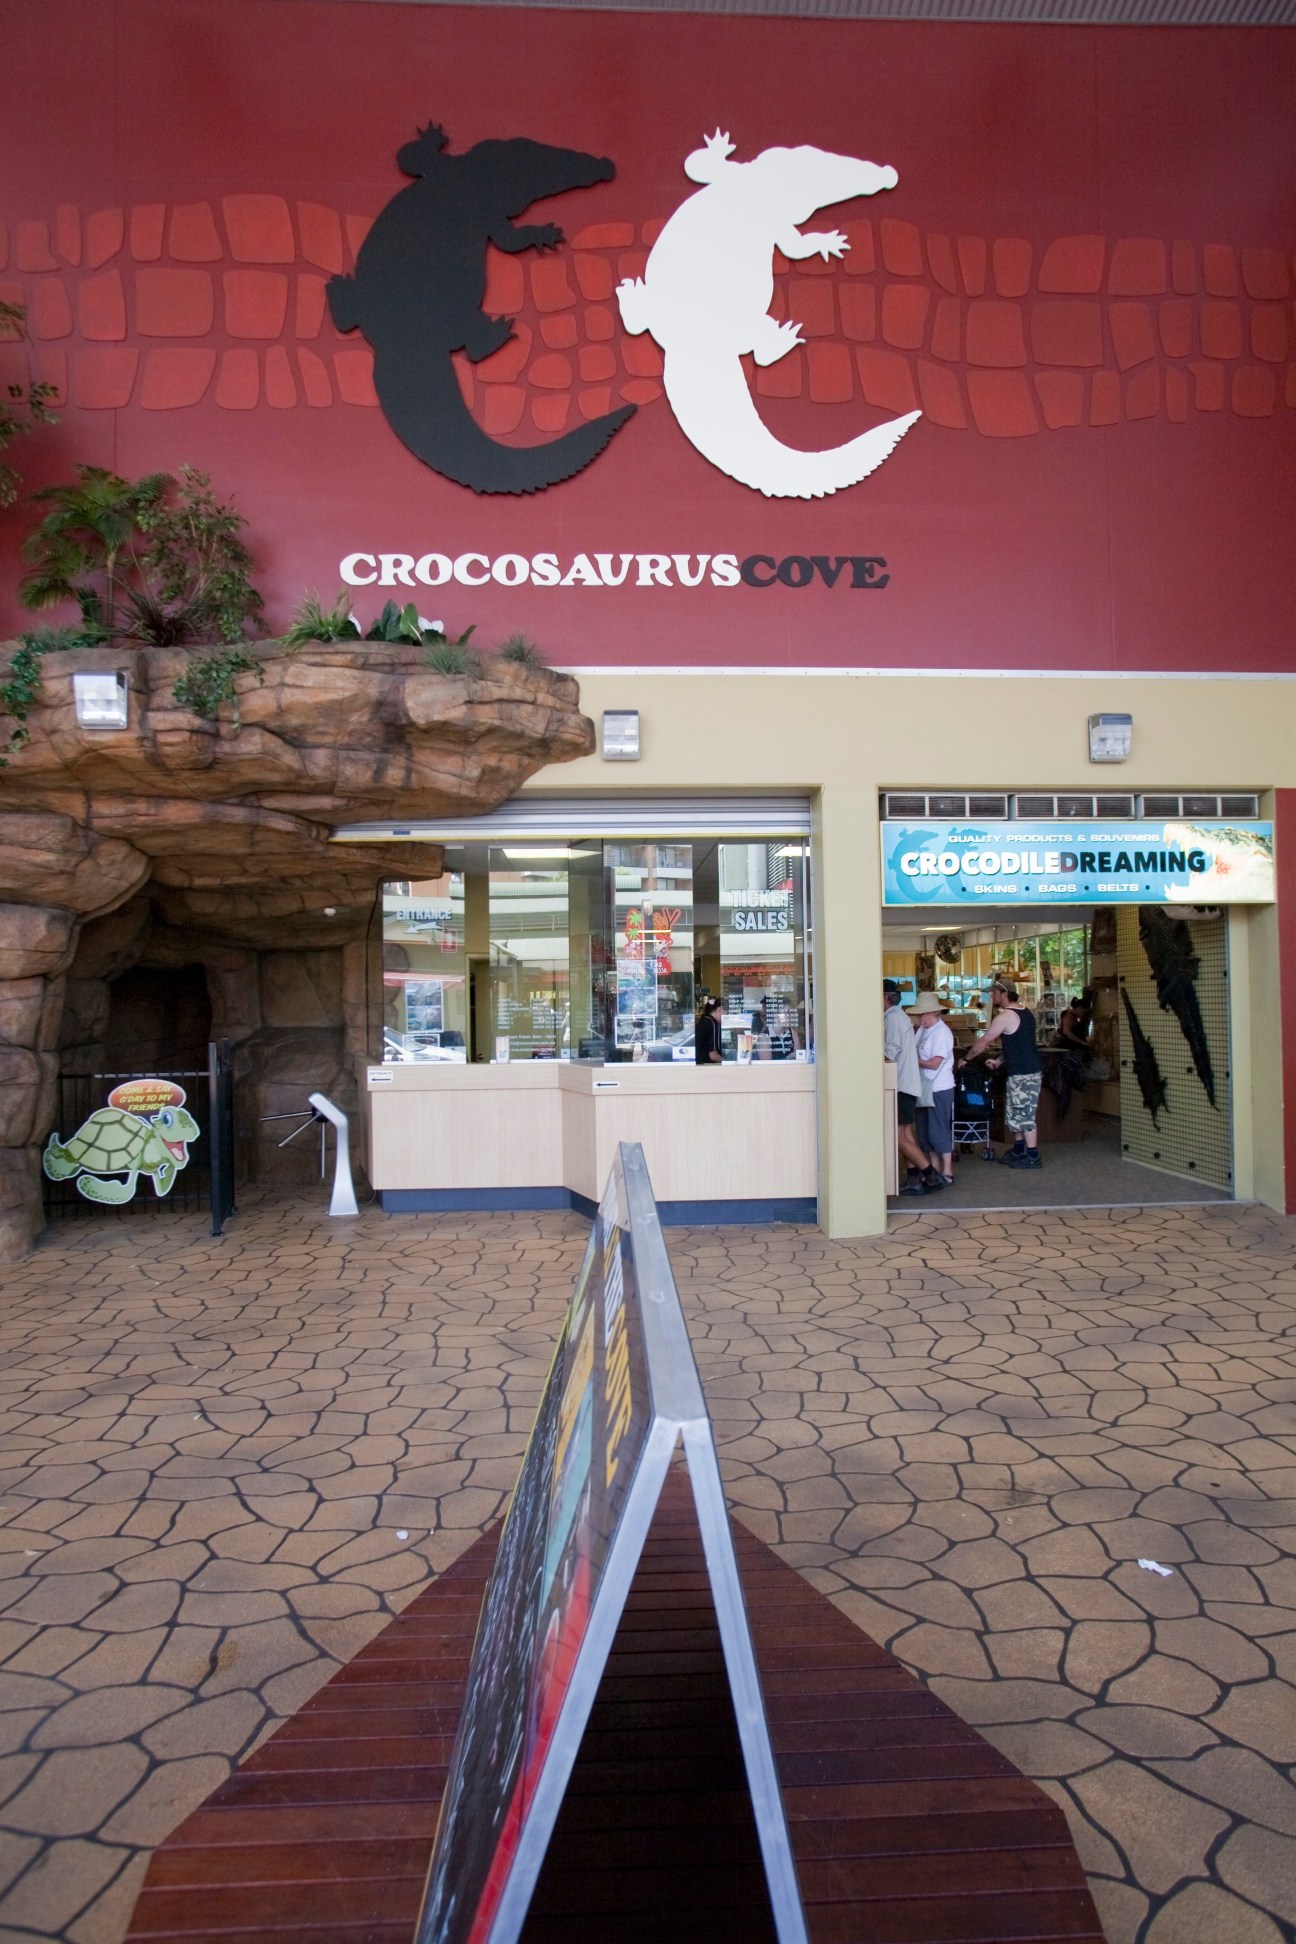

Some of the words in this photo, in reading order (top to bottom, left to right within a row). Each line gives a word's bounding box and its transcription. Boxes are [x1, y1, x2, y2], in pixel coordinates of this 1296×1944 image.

[948, 834, 1001, 844] QUALITY
[1006, 834, 1073, 843] PRODUCTS
[1077, 834, 1086, 843] &
[1090, 833, 1160, 843] SOUVENIRS
[974, 884, 1017, 894] SKINS
[1038, 883, 1077, 894] BAGS
[1097, 883, 1139, 893] BELTS
[731, 890, 790, 908] TICKET
[396, 908, 452, 920] ENTRANCE
[735, 911, 788, 931] SALES
[119, 1087, 145, 1095] COME
[155, 1085, 172, 1093] SAY
[146, 1094, 157, 1102] TO
[158, 1094, 172, 1102] MY
